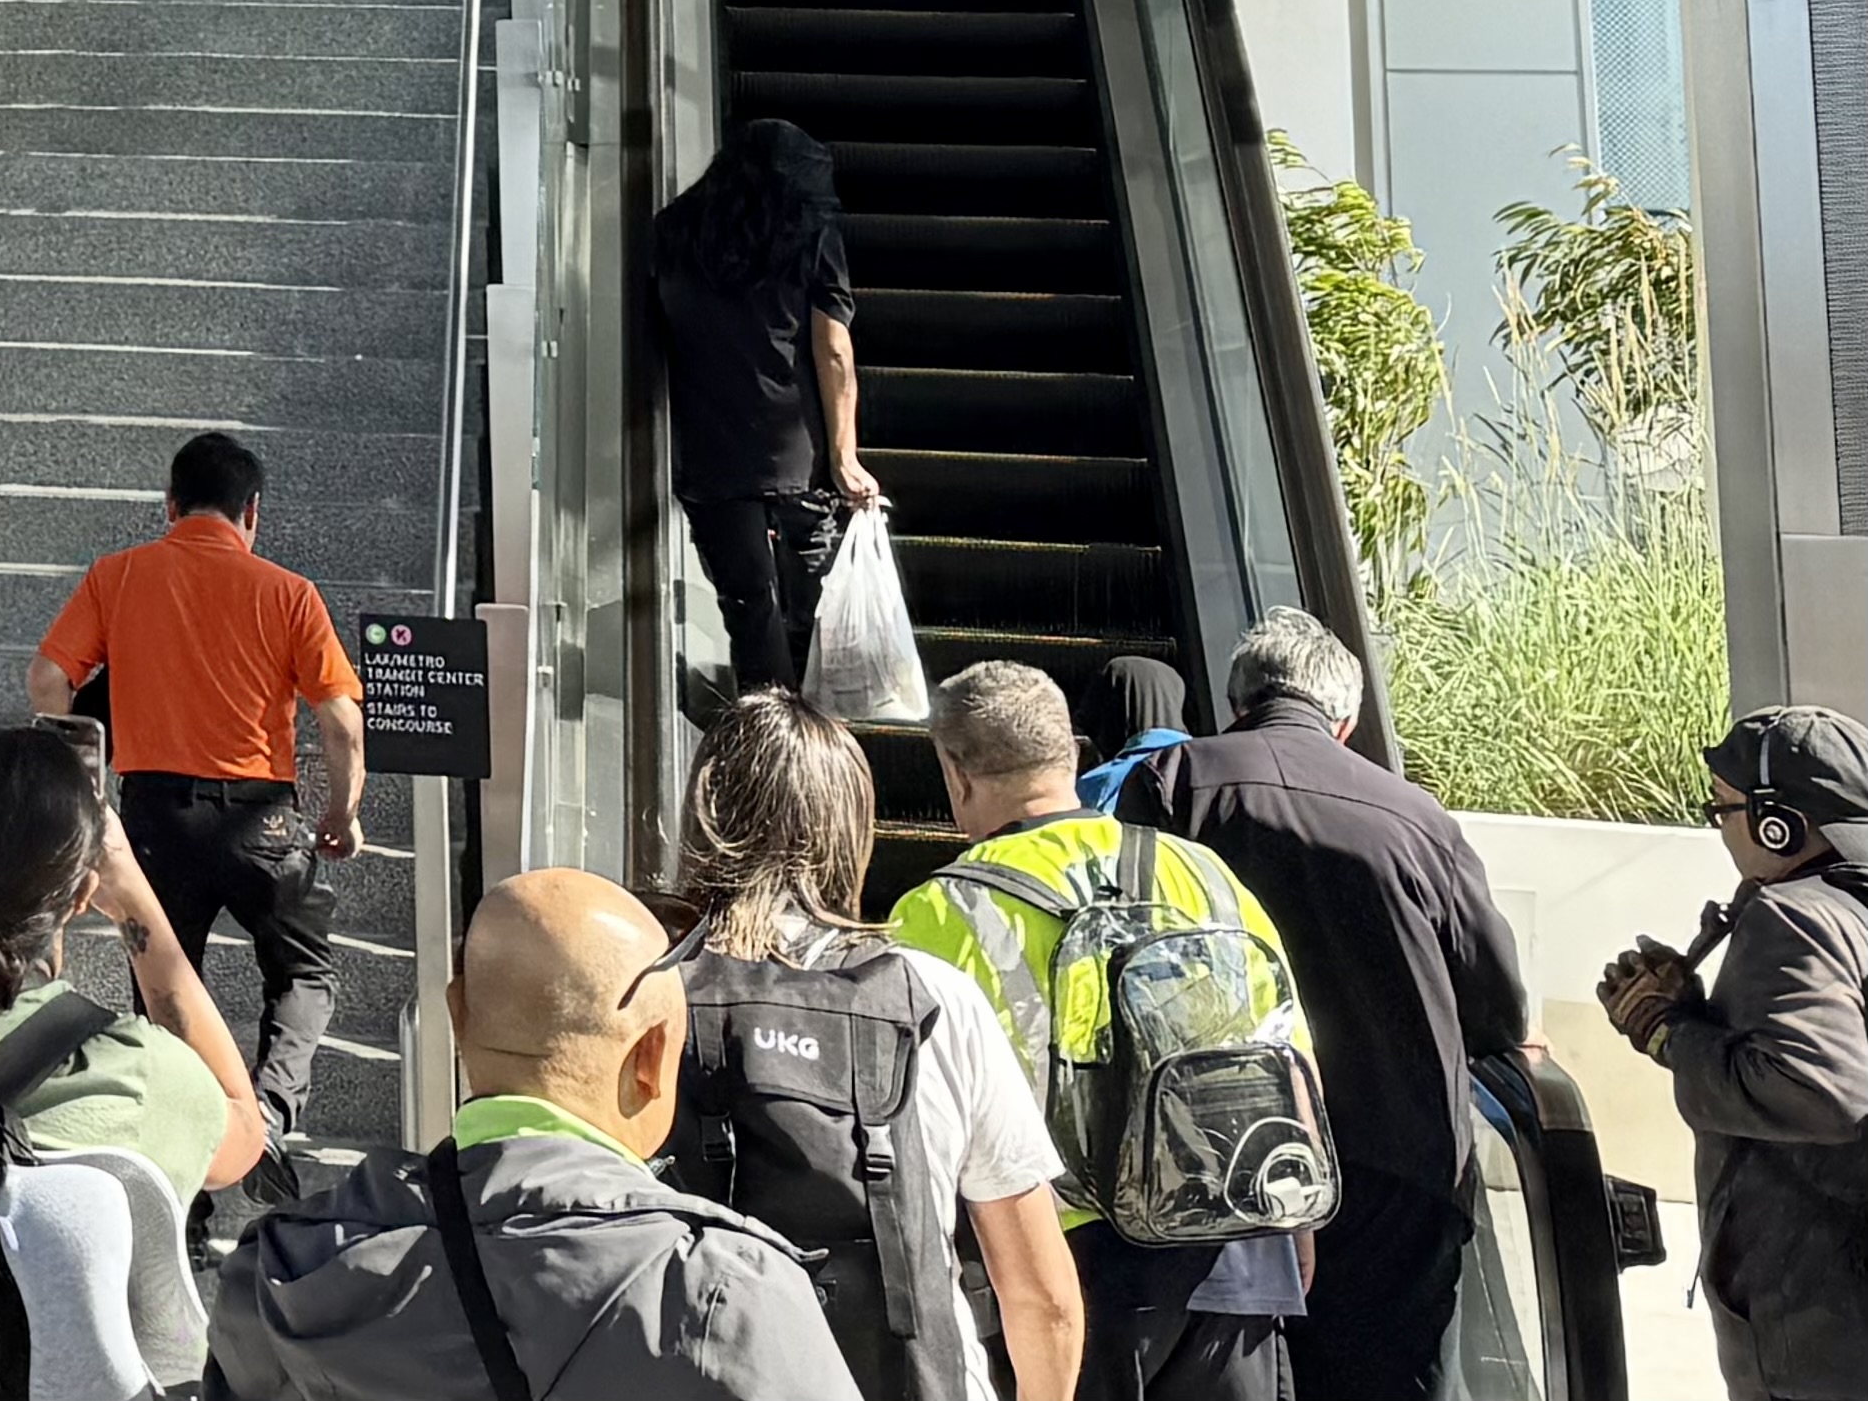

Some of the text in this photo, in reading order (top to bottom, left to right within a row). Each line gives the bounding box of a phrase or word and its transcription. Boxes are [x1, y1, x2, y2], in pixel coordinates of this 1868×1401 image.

[366, 667, 484, 687] TRANSIT CENTER
[366, 682, 425, 698] STATION
[366, 701, 438, 718] STAIRS TO
[366, 717, 453, 735] CONCOURSE
[754, 1027, 820, 1061] UKG
